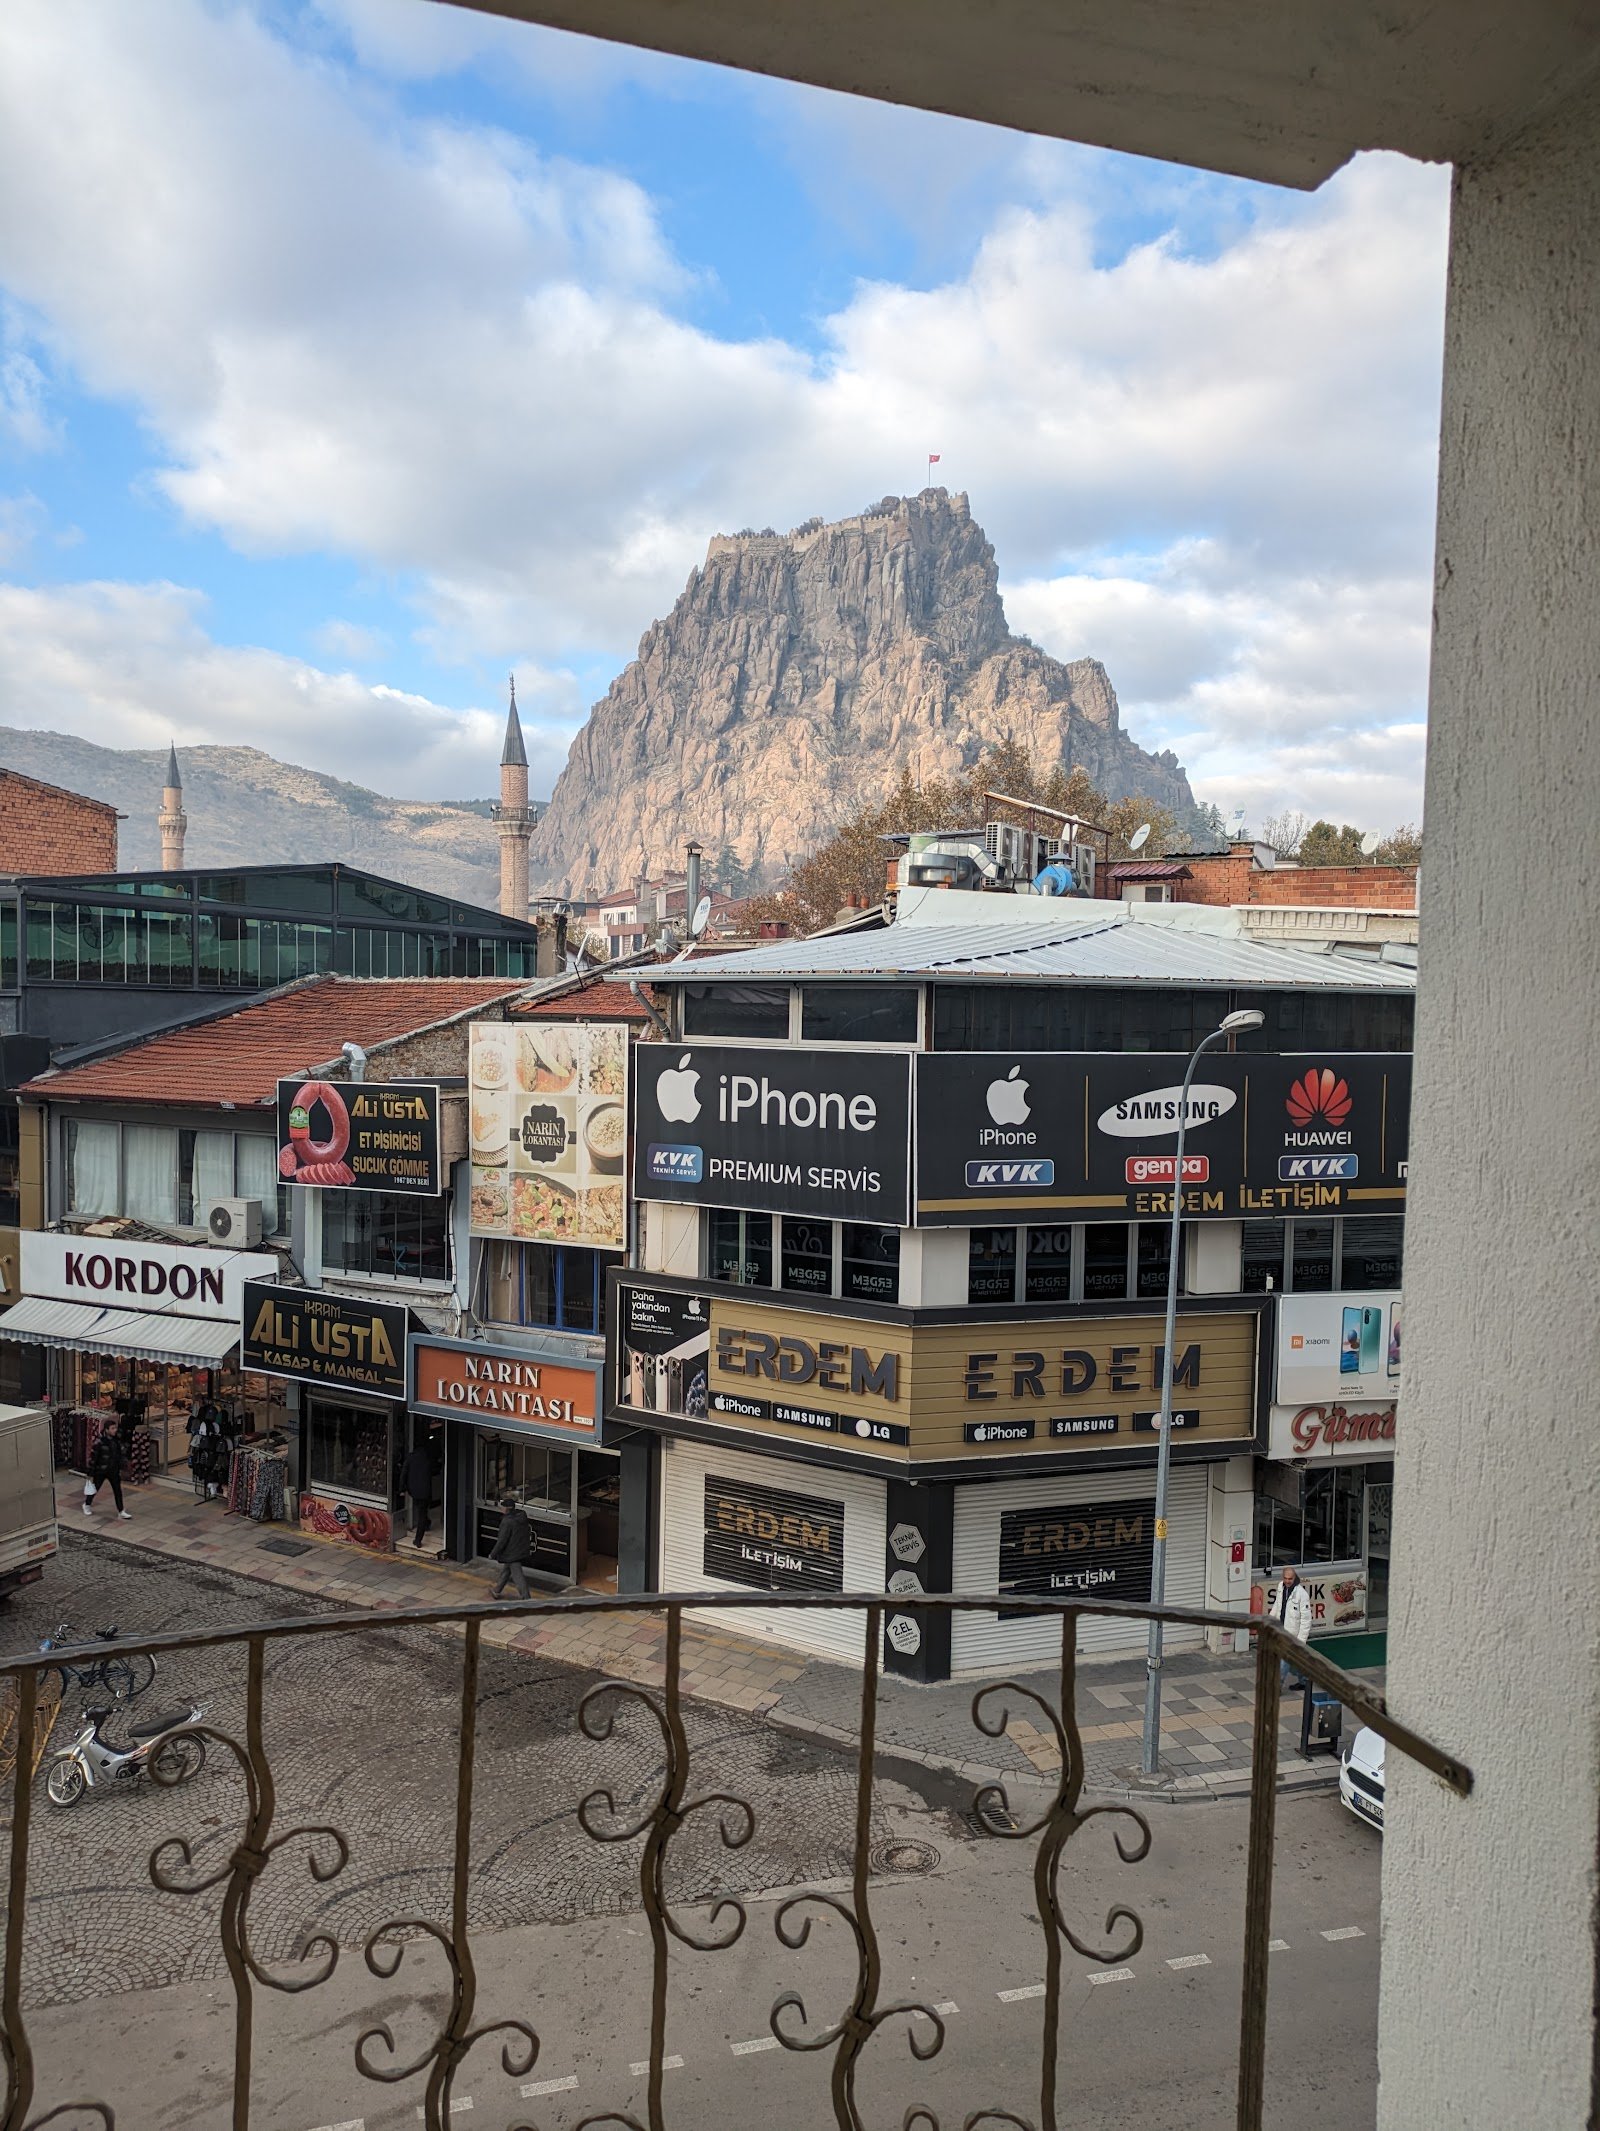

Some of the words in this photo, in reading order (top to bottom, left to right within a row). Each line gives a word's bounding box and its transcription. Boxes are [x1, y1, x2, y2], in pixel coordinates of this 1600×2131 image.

[384, 1097, 429, 1120] USTA
[719, 1074, 877, 1131] iPhone
[1116, 1102, 1220, 1120] SAMSUNG
[526, 1120, 560, 1136] NARİN
[980, 1128, 1036, 1145] iPhone
[360, 1132, 372, 1148] ET
[374, 1130, 422, 1153] PİŞİRİCİSİ
[524, 1136, 564, 1146] LOKANTASI
[1284, 1131, 1352, 1146] HUAWEI
[352, 1156, 387, 1174] SUCUK
[390, 1156, 429, 1177] GÖMME
[653, 1152, 696, 1166] KVK
[1288, 1158, 1349, 1176] KVK
[653, 1166, 674, 1174] TEKNİK
[709, 1158, 802, 1186] PREMIUM
[808, 1166, 881, 1192] SERVİS
[976, 1164, 1044, 1182] KVK
[1135, 1191, 1224, 1212] ERDEM
[1240, 1182, 1341, 1210] İLETİŞİM
[66, 1252, 224, 1304] KORDON
[632, 1290, 654, 1302] Daha
[304, 1300, 341, 1319] İKRAM
[632, 1301, 670, 1313] yakından
[632, 1312, 657, 1323] bakın.
[310, 1317, 397, 1368] USTA
[263, 1350, 310, 1370] KASAP
[313, 1360, 321, 1372] &
[324, 1361, 382, 1384] MANGAL
[465, 1357, 542, 1388] NARİN
[716, 1327, 900, 1403] ERDEM
[964, 1344, 1201, 1400] ERDEM
[437, 1379, 574, 1423] LOKANTASI
[726, 1398, 761, 1416] iPhone
[776, 1407, 832, 1428] SAMSUNG
[1056, 1419, 1114, 1433] SAMSUNG
[1170, 1414, 1184, 1426] LG
[872, 1424, 890, 1440] LG
[987, 1426, 1027, 1440] iPhone
[716, 1499, 830, 1552] ERDEM
[894, 1530, 916, 1545] TEKNİK
[1022, 1516, 1144, 1556] ERDEM
[898, 1540, 920, 1554] SERVİS
[742, 1544, 802, 1572] İLETİŞİM
[1050, 1568, 1116, 1588] İLETİŞİM
[893, 1622, 912, 1636] 2.EL
